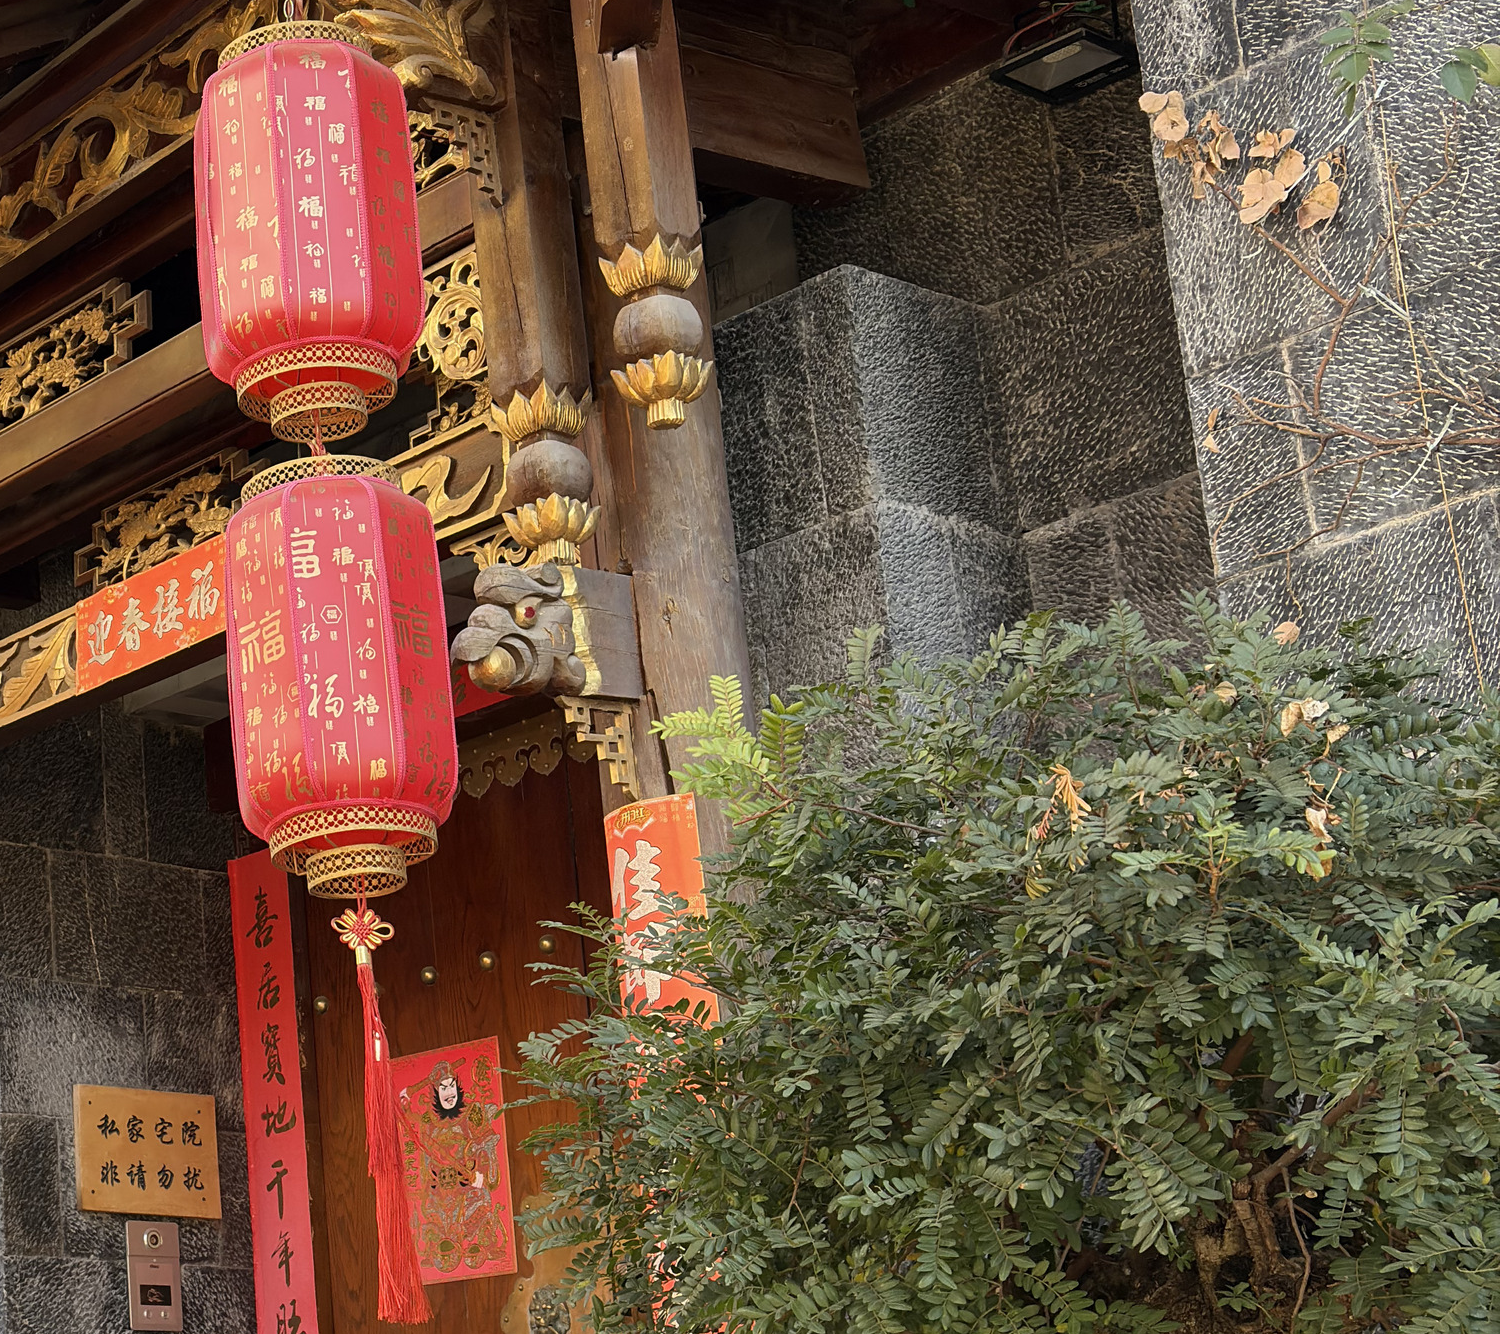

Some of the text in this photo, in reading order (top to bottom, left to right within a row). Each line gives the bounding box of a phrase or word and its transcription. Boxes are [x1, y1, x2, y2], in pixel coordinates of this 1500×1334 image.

[87, 561, 221, 666] 迎春接福
[97, 1114, 203, 1147] 私家宅院
[100, 1160, 205, 1192] 非请勿扰
